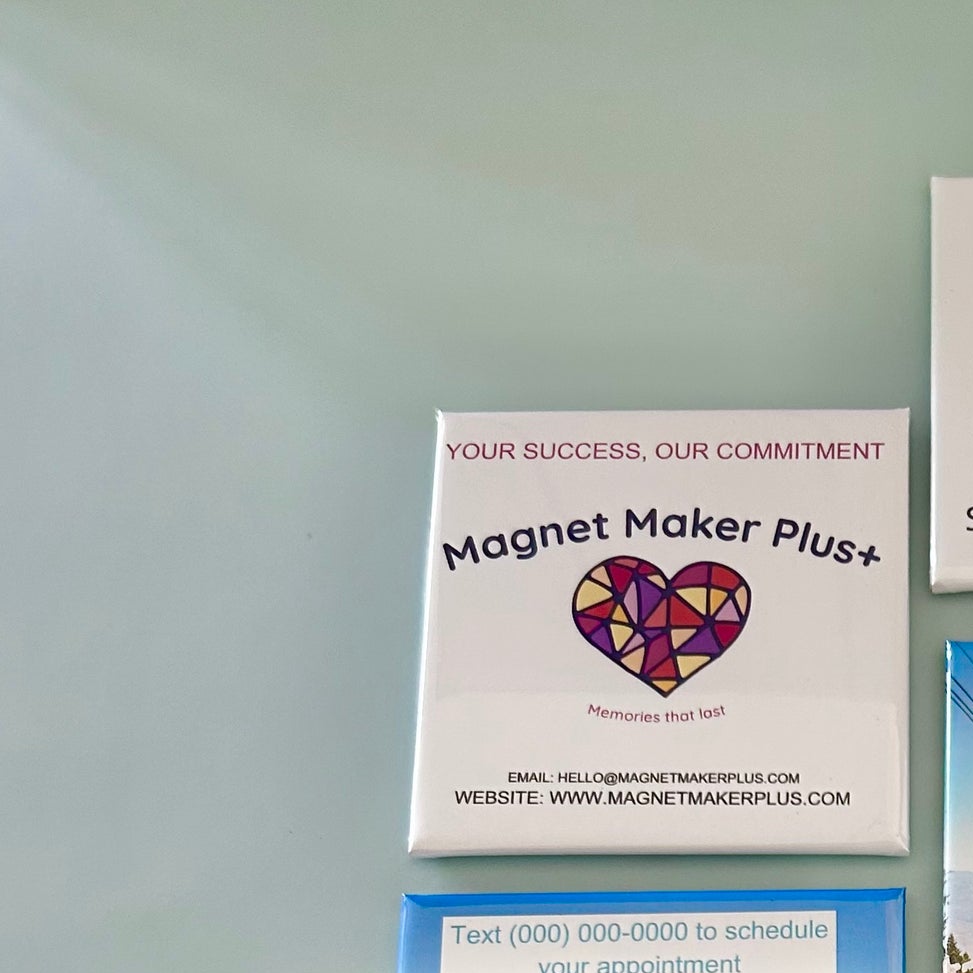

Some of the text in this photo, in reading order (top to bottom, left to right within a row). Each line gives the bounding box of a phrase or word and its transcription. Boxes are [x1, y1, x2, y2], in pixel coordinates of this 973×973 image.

[447, 443, 884, 461] YOUR SUCCESS, OUR COMMITMENT
[443, 508, 880, 571] Magnet Maker Plus+
[588, 704, 725, 723] Memories that last
[508, 772, 799, 785] EMAIL: HELLO@MAGNETMAKERPLUS.COM
[455, 791, 850, 805] WEBSITE: WWW.MAGNETMAKERPLUS.COM
[451, 920, 829, 948] Text (000) 000-0000 to schedule
